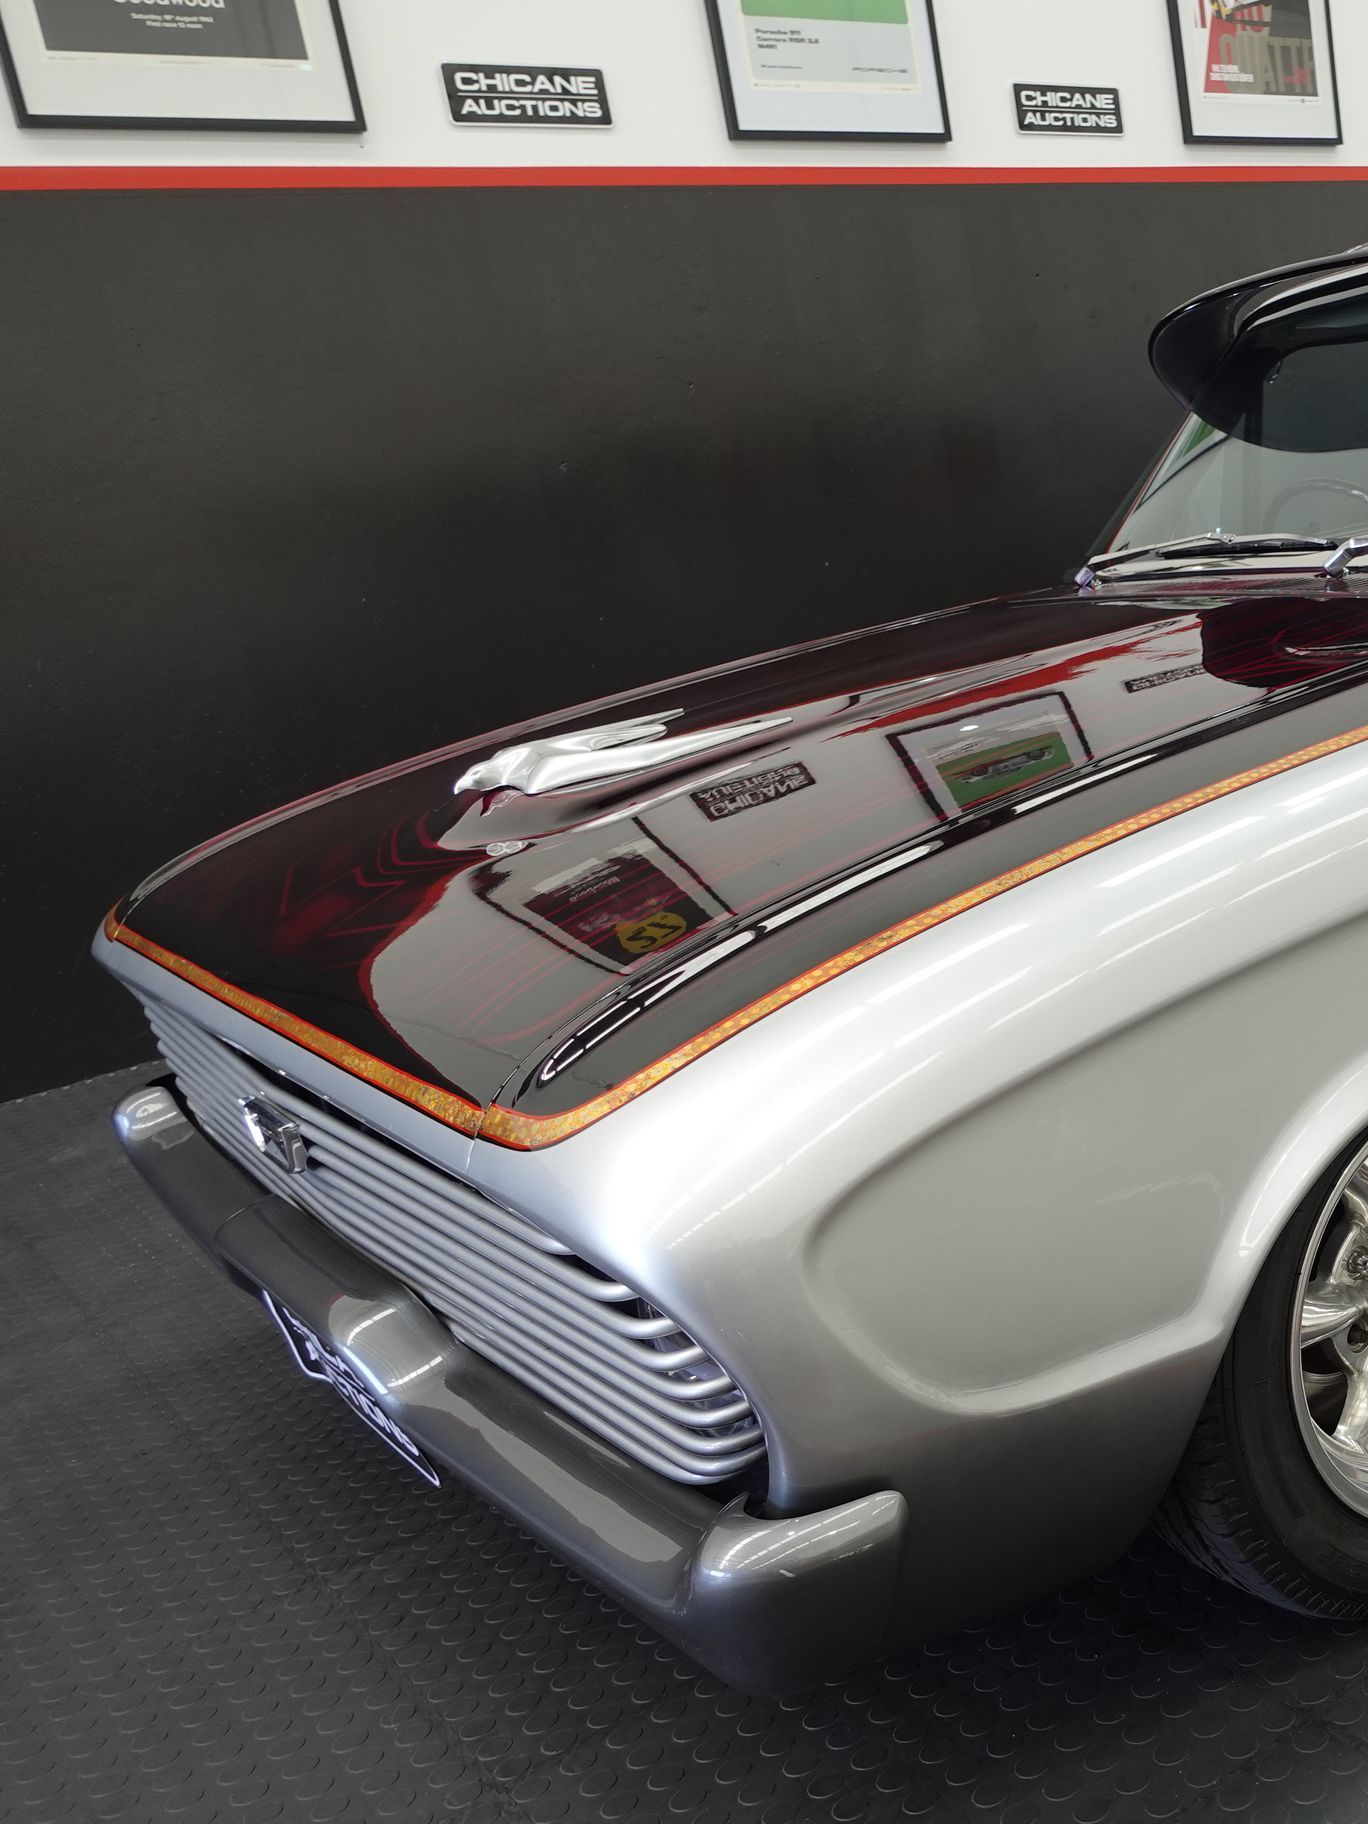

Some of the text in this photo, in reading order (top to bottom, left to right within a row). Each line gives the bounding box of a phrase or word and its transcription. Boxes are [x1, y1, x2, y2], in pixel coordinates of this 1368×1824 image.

[454, 72, 599, 95] CHICANE
[460, 98, 603, 118] AUCTIONS
[1020, 90, 1116, 109] CHICANE
[1023, 112, 1118, 128] AUCTIONS
